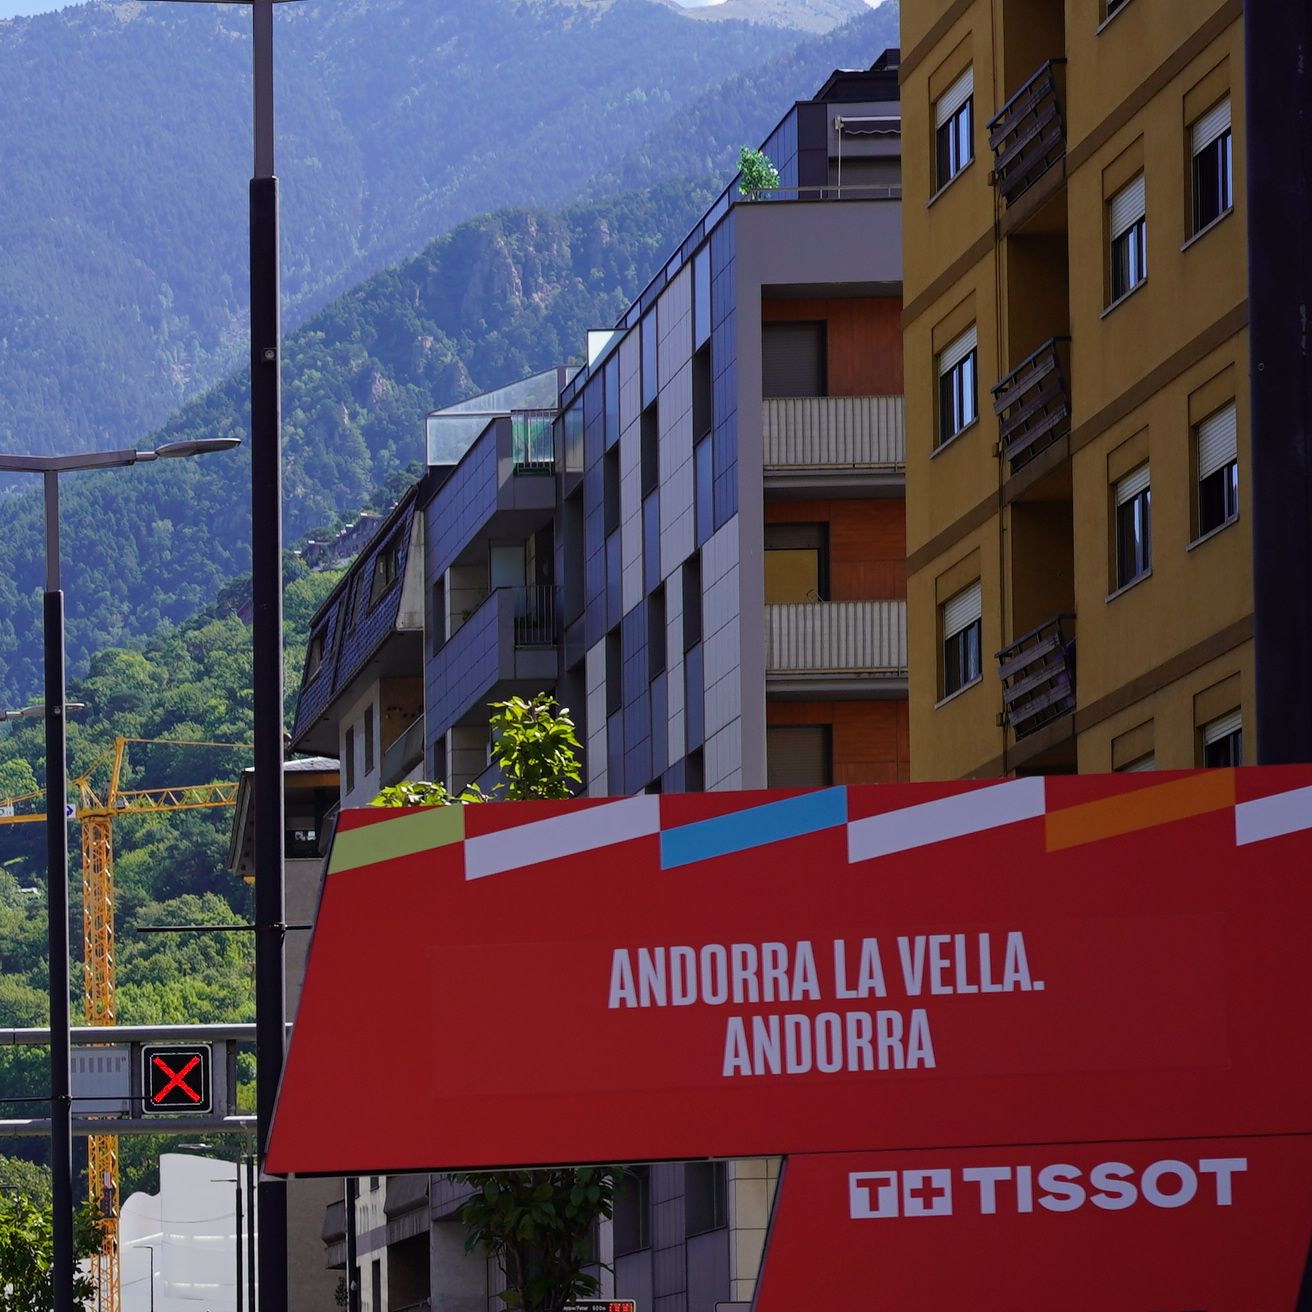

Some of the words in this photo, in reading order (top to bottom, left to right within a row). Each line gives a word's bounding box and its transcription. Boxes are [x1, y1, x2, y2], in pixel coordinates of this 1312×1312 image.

[609, 941, 820, 1008] ANDORRA
[834, 938, 886, 998] LA
[898, 932, 1044, 995] VELLA.
[722, 1008, 936, 1076] ANDORRA
[963, 1158, 1246, 1213] TISSOT
